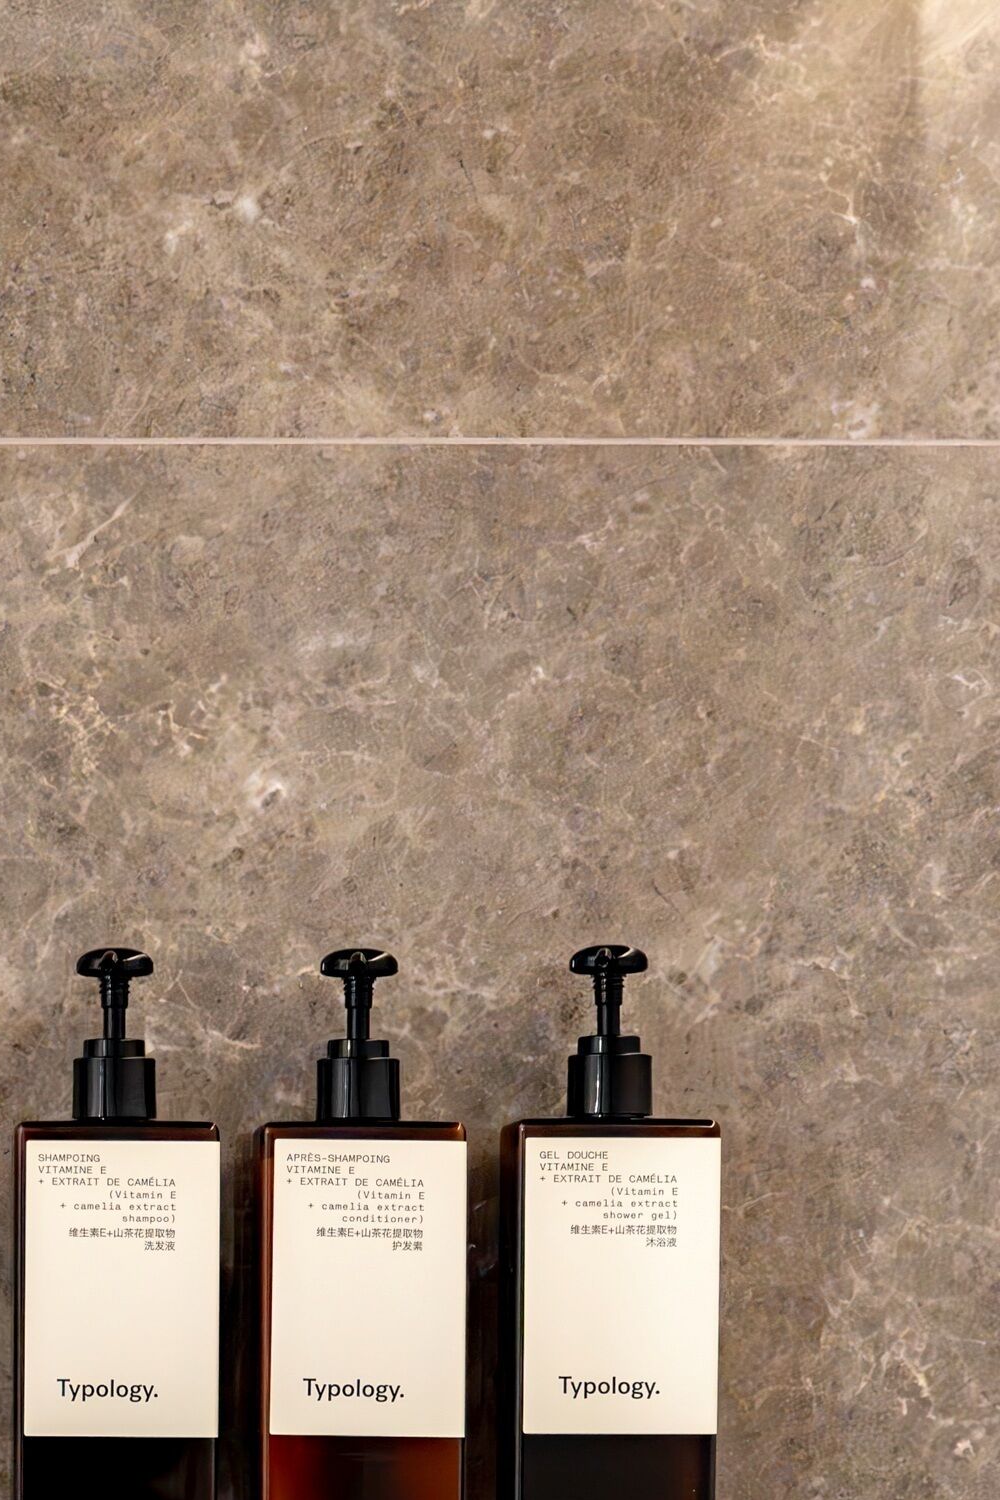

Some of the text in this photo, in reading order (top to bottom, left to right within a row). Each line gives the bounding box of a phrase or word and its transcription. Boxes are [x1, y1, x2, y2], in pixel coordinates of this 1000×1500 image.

[38, 1154, 100, 1162] SHAMPOING
[287, 1152, 390, 1163] APRÈS-SHAMPOING
[540, 1151, 608, 1159] GEL DOUCHE
[38, 1166, 107, 1174] VITAMINE E
[287, 1165, 355, 1174] VITAMINE E
[540, 1163, 609, 1171] VITAMINE E
[52, 1177, 99, 1186] EXTRAIT
[107, 1178, 120, 1186] DE
[127, 1177, 175, 1187] CAMÉLIA
[300, 1177, 347, 1186] EXTRAIT
[355, 1178, 368, 1186] DE
[376, 1177, 424, 1187] CAMÉLIA
[554, 1174, 601, 1183] EXTRAIT
[609, 1175, 622, 1183] DE
[629, 1173, 677, 1183] CAMÉLIA
[110, 1190, 177, 1199] (Vitamin E
[358, 1190, 426, 1200] (Vitamin E
[611, 1187, 679, 1196] (Vitamin E
[74, 1202, 121, 1210] camelia
[322, 1202, 369, 1210] camelia
[575, 1199, 623, 1207] camelia
[122, 1214, 175, 1224] shampoo)
[342, 1215, 423, 1224] conditioner)
[603, 1210, 676, 1221] shower gel)
[57, 1379, 158, 1402] Typology.
[303, 1378, 404, 1402] Typology.
[558, 1376, 660, 1399] Typology.
